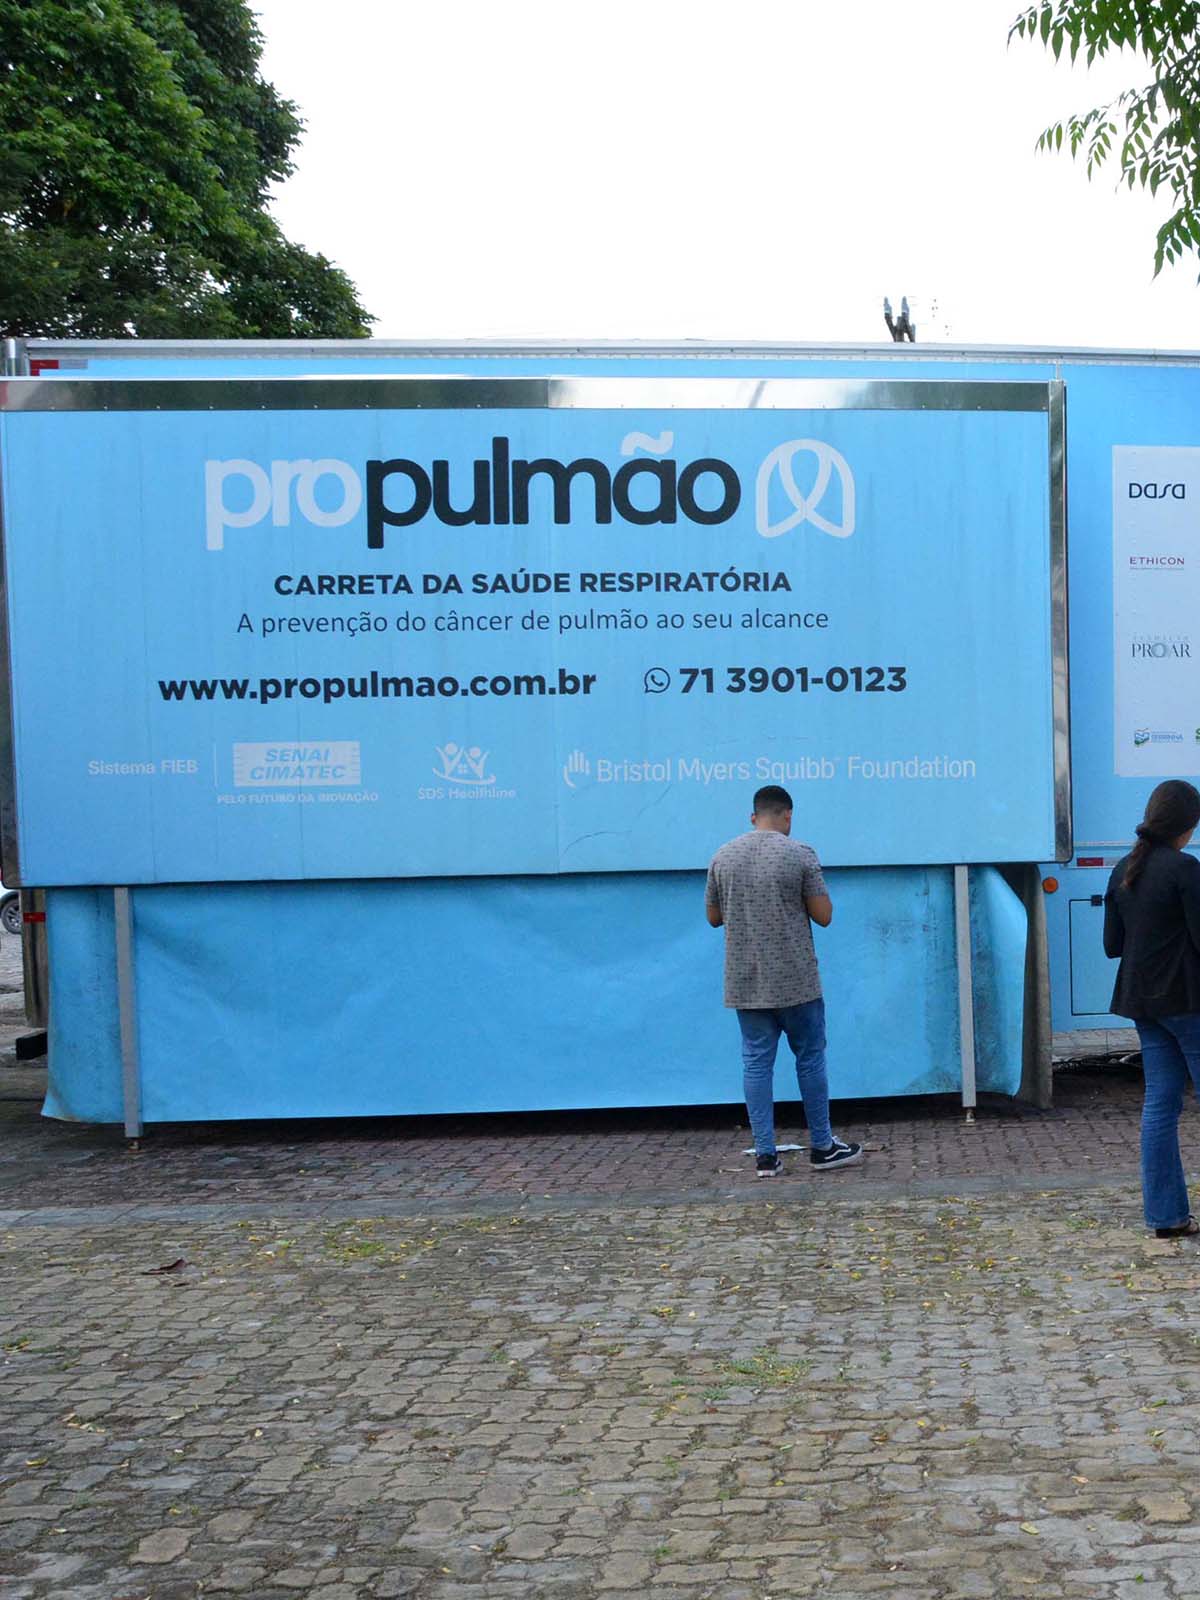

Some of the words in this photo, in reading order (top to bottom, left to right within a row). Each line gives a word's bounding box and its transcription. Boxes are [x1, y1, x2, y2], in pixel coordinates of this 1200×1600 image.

[204, 431, 742, 551] propulmão
[1129, 556, 1185, 565] ETHICON
[274, 574, 414, 596] CARRETA
[422, 573, 464, 594] DA
[471, 567, 571, 594] SAÚDE
[580, 566, 792, 593] RESPIRATÓRIA
[236, 613, 254, 633] A
[262, 611, 389, 637] prevenção
[396, 610, 427, 632] do
[434, 610, 514, 632] câncer
[521, 609, 550, 630] de
[559, 608, 648, 634] pulmão
[656, 613, 685, 629] ao
[693, 612, 733, 628] seu
[741, 608, 829, 629] alcance
[1131, 642, 1192, 658] PROAR
[158, 668, 597, 703] www.propulmao.com.br
[679, 667, 714, 693] 71
[726, 666, 908, 693] 3901-0123
[88, 760, 156, 775] Sistema
[161, 759, 199, 774] FIEB
[265, 748, 331, 762] SENAI
[250, 765, 346, 780] CIMATEC
[597, 760, 672, 782] Bristol
[677, 759, 750, 785] Myers
[756, 757, 836, 783] Squibb
[847, 756, 977, 779] Foundation
